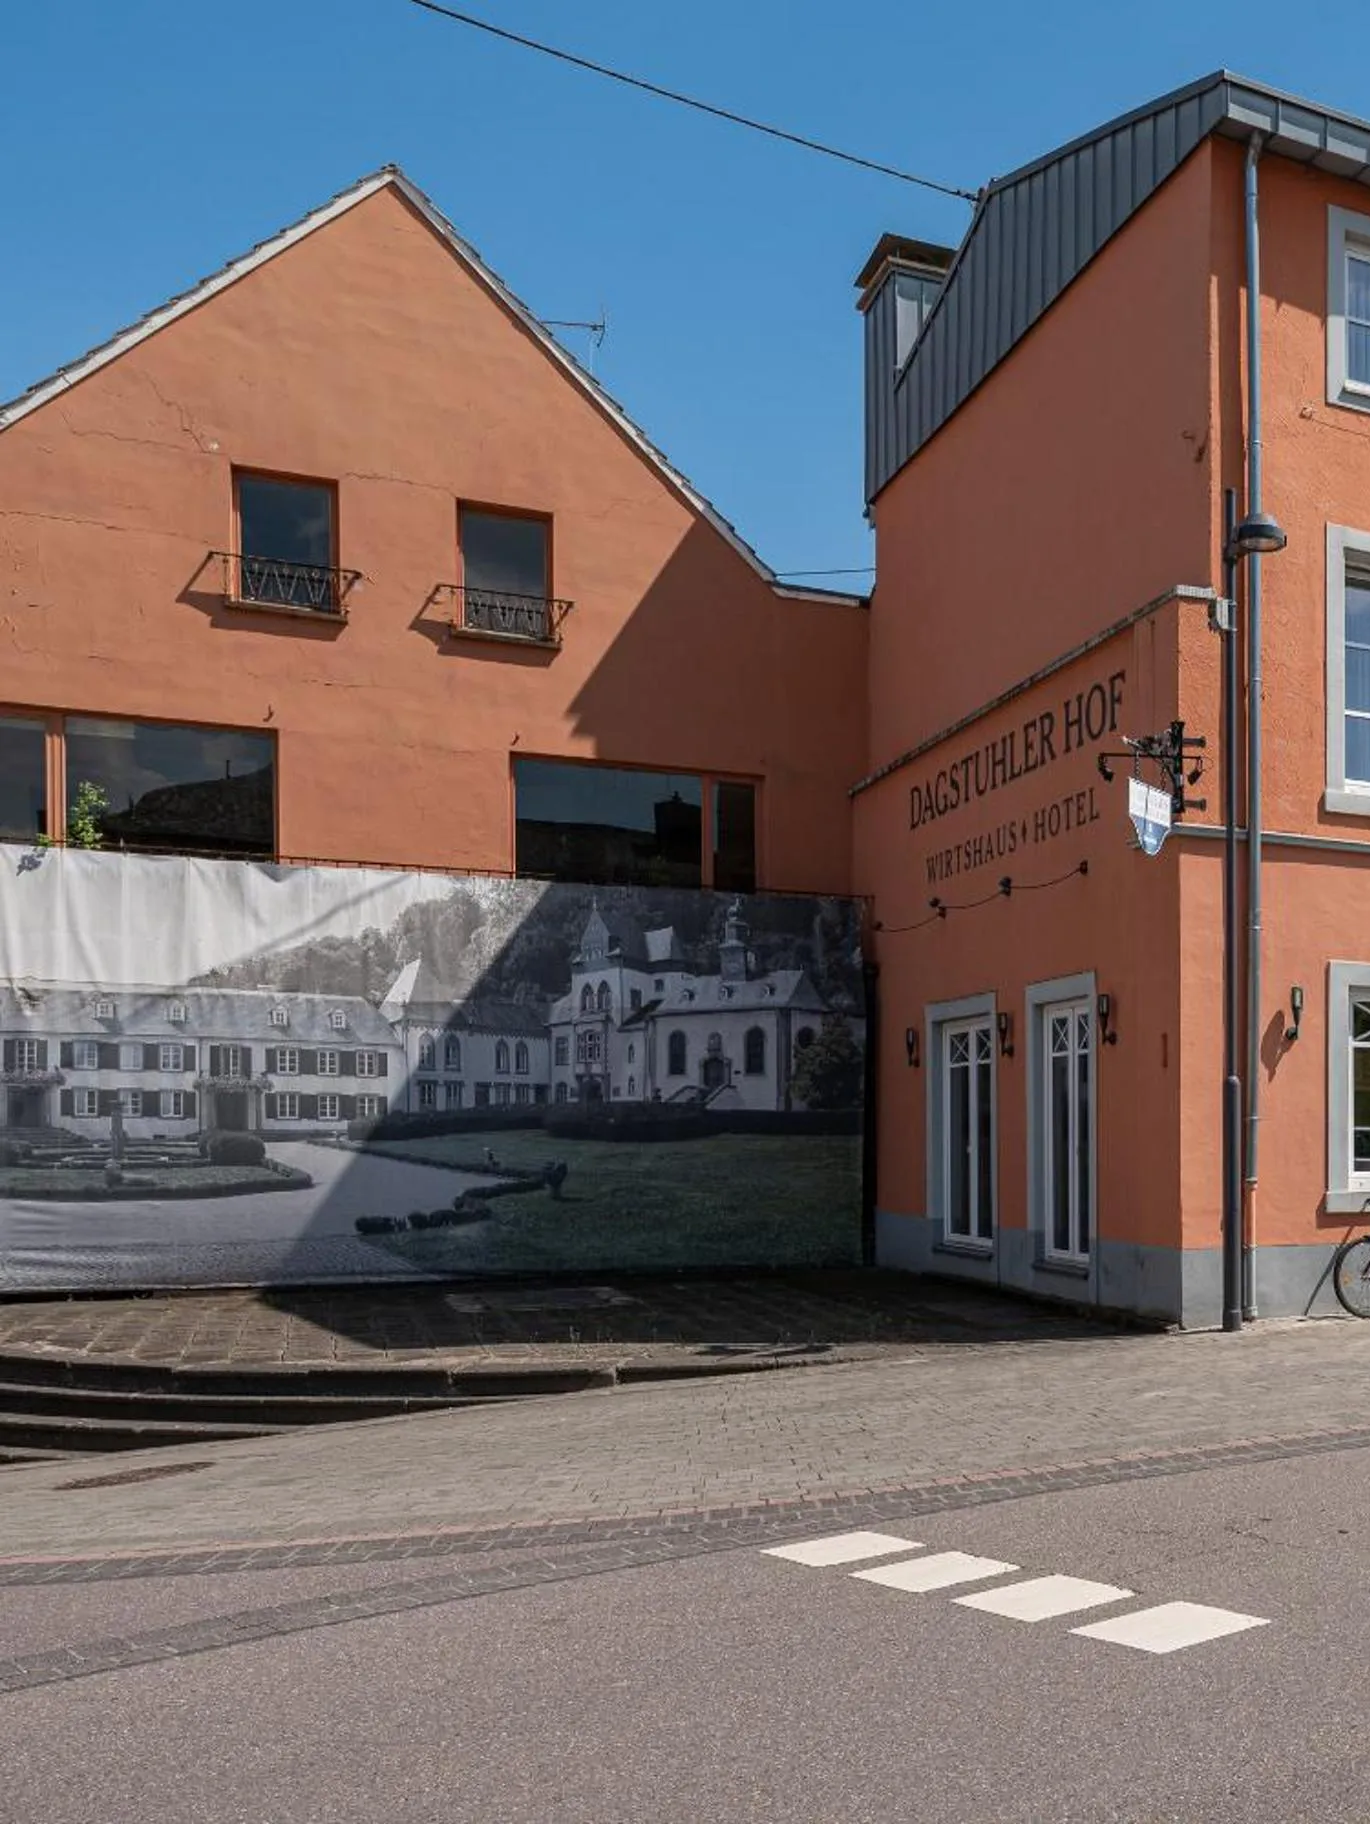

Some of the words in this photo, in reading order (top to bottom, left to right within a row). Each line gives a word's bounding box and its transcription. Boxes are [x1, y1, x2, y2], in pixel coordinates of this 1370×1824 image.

[909, 711, 1056, 831] DAGSTUHLER
[1063, 670, 1127, 753] HOF
[925, 823, 1018, 885] WIRTSHAUS
[1033, 787, 1100, 843] HOTEL
